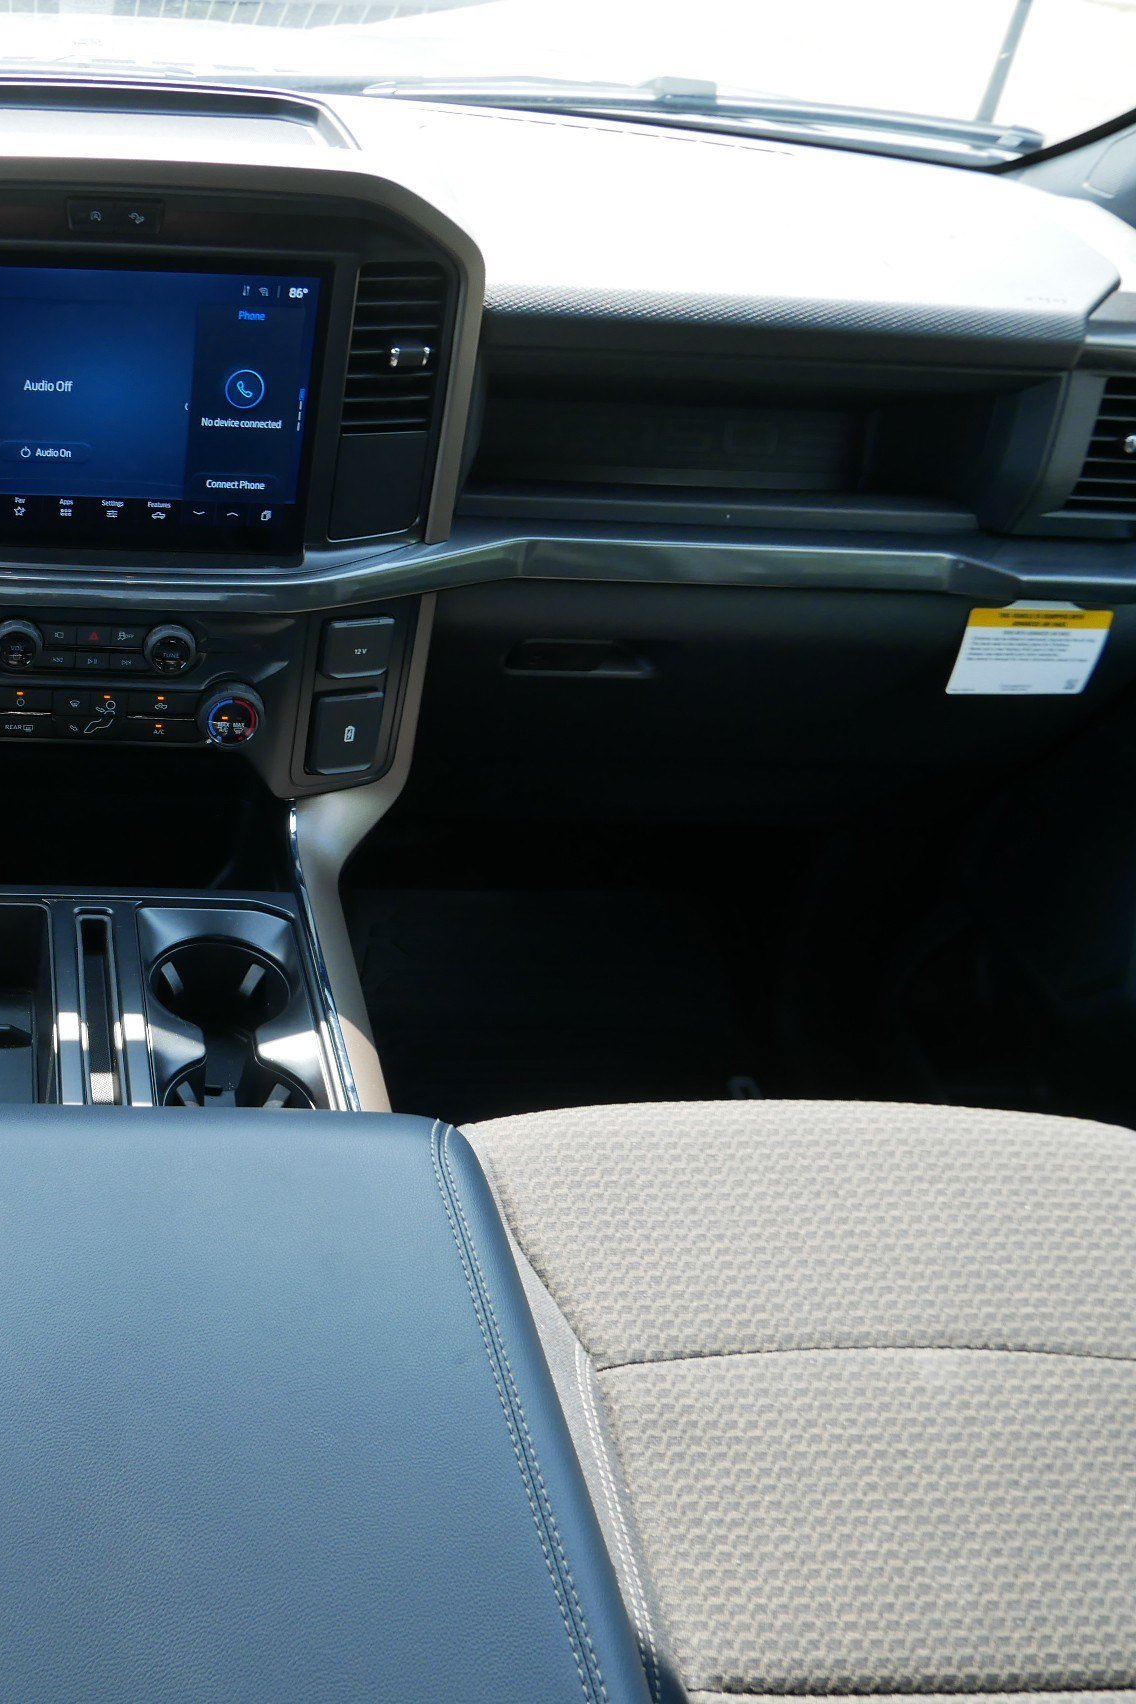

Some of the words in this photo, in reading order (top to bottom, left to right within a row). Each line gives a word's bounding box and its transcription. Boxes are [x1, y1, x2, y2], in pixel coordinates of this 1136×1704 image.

[238, 310, 266, 321] Phone
[23, 379, 54, 392] Audio
[56, 379, 73, 392] Off
[201, 418, 213, 427] No
[214, 418, 239, 428] device
[240, 418, 282, 429] connected
[36, 448, 58, 458] Audio
[59, 448, 72, 458] On
[206, 479, 236, 489] Connect
[238, 480, 265, 490] Phone
[59, 498, 73, 506] Apps
[101, 500, 124, 508] Settings
